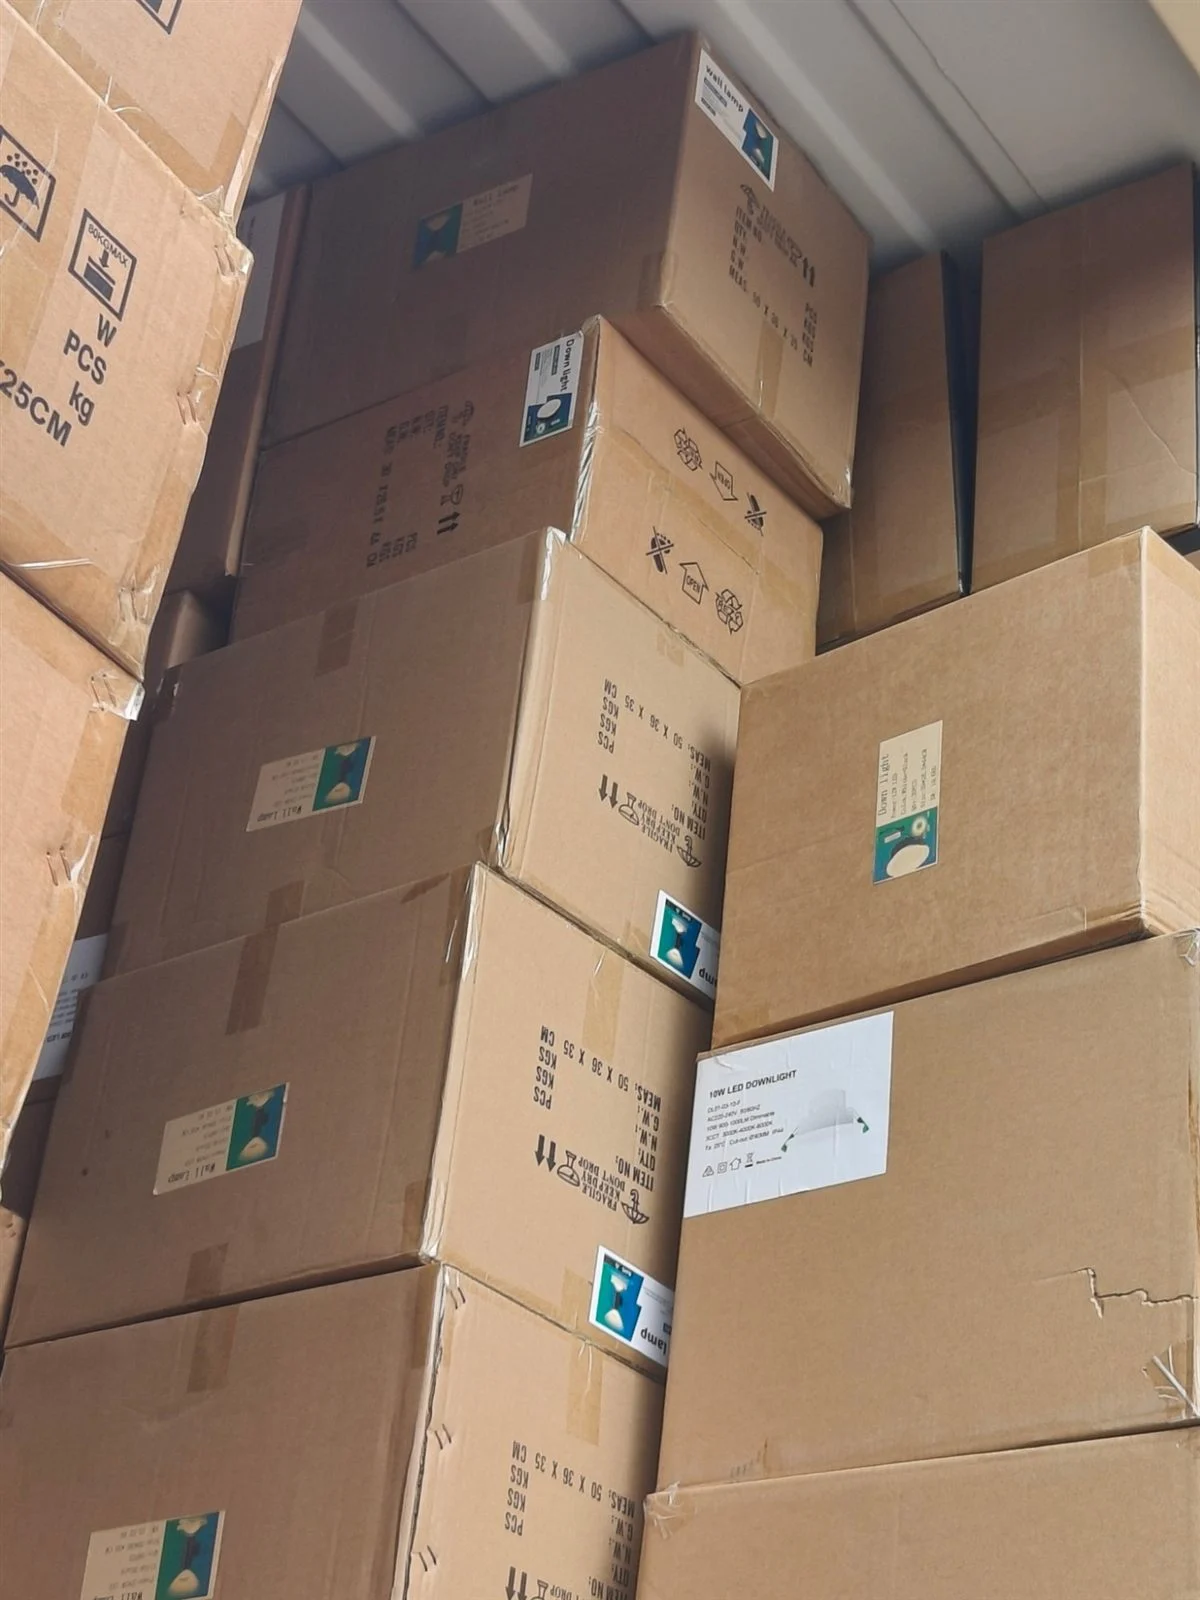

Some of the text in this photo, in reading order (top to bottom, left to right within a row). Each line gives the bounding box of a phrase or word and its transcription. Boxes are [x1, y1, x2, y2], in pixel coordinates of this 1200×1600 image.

[96, 312, 117, 348] W
[63, 328, 107, 385] PCS
[563, 338, 575, 368] Down
[0, 359, 72, 448] 25CM
[68, 380, 94, 426] kg
[717, 471, 730, 490] OPEN
[686, 575, 700, 593] OPEN
[604, 678, 618, 699] CM
[602, 696, 620, 720] KGS
[624, 695, 634, 712] 35
[638, 704, 644, 720] X
[600, 713, 617, 736] KGS
[663, 724, 668, 740] X
[598, 731, 615, 754] PCS
[674, 732, 683, 750] 50
[686, 815, 706, 840] ITEM
[538, 1046, 558, 1070] KGS
[540, 1025, 662, 1112] MEAS: 50 X 36 X 35 CM
[536, 1066, 554, 1090] KGS
[710, 1070, 797, 1099] 10W LED DOWNLIGHT
[533, 1086, 656, 1172] QTY: PCS
[578, 1156, 600, 1176] DROP
[615, 1155, 654, 1192] ITEM NO:
[582, 1182, 618, 1212] FRAGILE
[640, 1327, 667, 1355] lamp
[510, 1464, 530, 1490] KGS
[512, 1440, 636, 1518] MEAS: 50 X 36 X 35 CM
[507, 1488, 526, 1512] KGS
[504, 1512, 524, 1536] PCS
[588, 1576, 604, 1600] NO:
